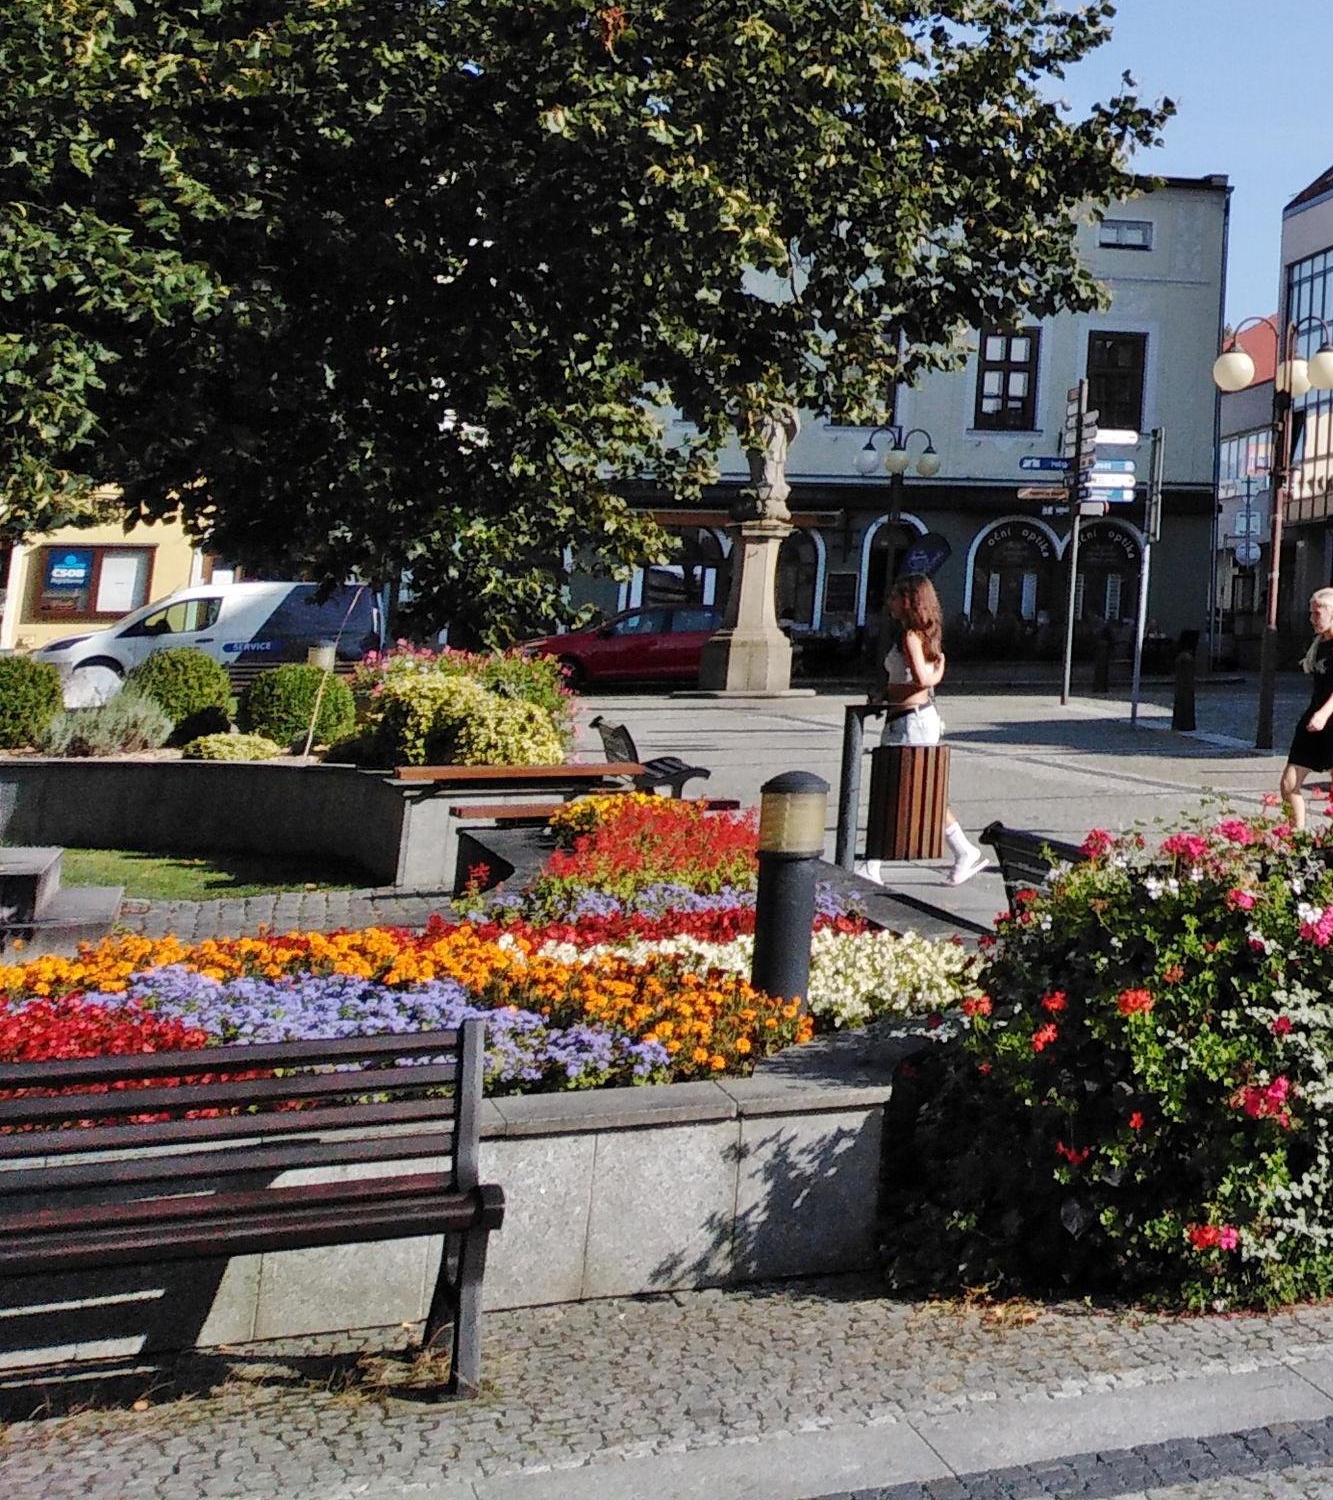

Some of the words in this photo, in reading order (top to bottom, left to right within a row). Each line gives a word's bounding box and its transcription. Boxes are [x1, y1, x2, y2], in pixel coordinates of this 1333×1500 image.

[987, 526, 1012, 546] oční
[1021, 529, 1050, 558] optika
[1108, 530, 1136, 559] optika
[232, 642, 272, 652] SERVICE
